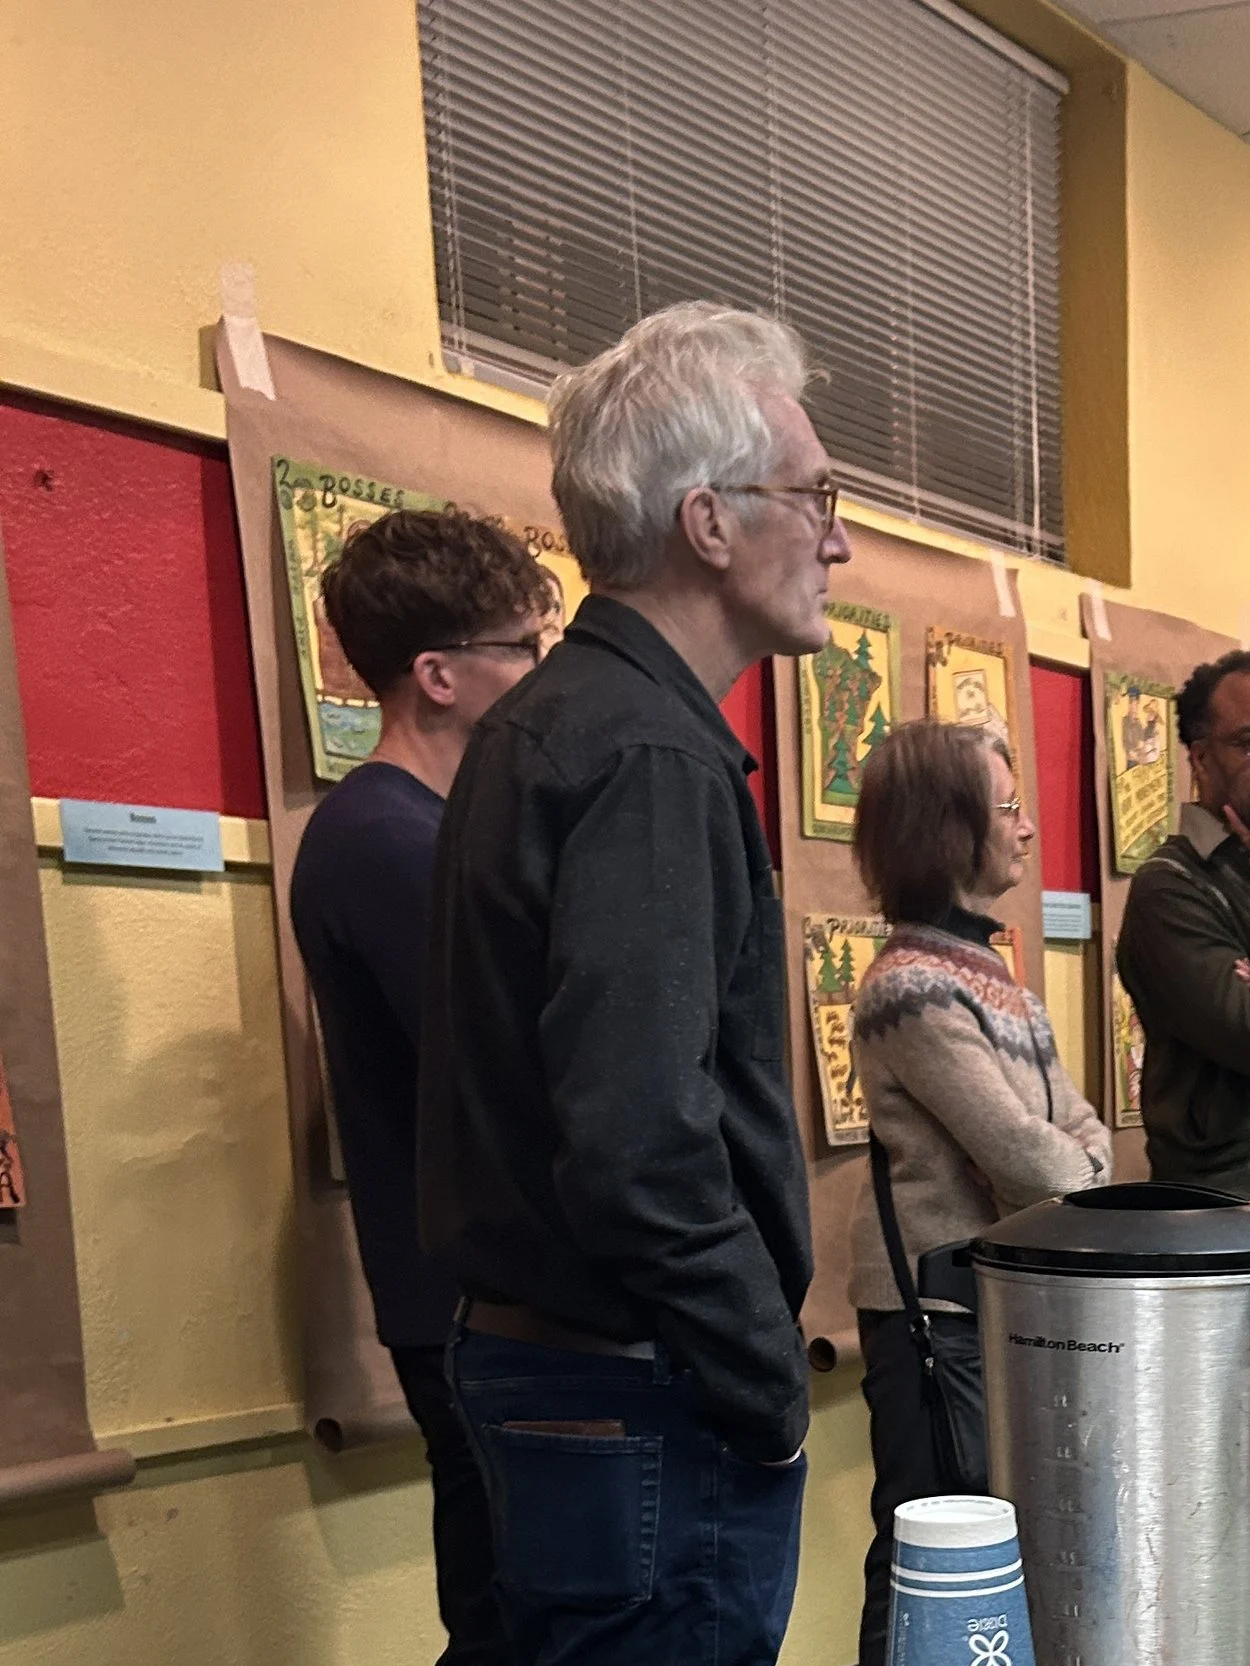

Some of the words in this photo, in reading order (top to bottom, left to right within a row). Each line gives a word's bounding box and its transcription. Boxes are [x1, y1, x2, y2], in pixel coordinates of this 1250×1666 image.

[320, 474, 405, 508] BOSSES
[1009, 1332, 1065, 1350] Hamilton
[1068, 1340, 1120, 1353] Beach
